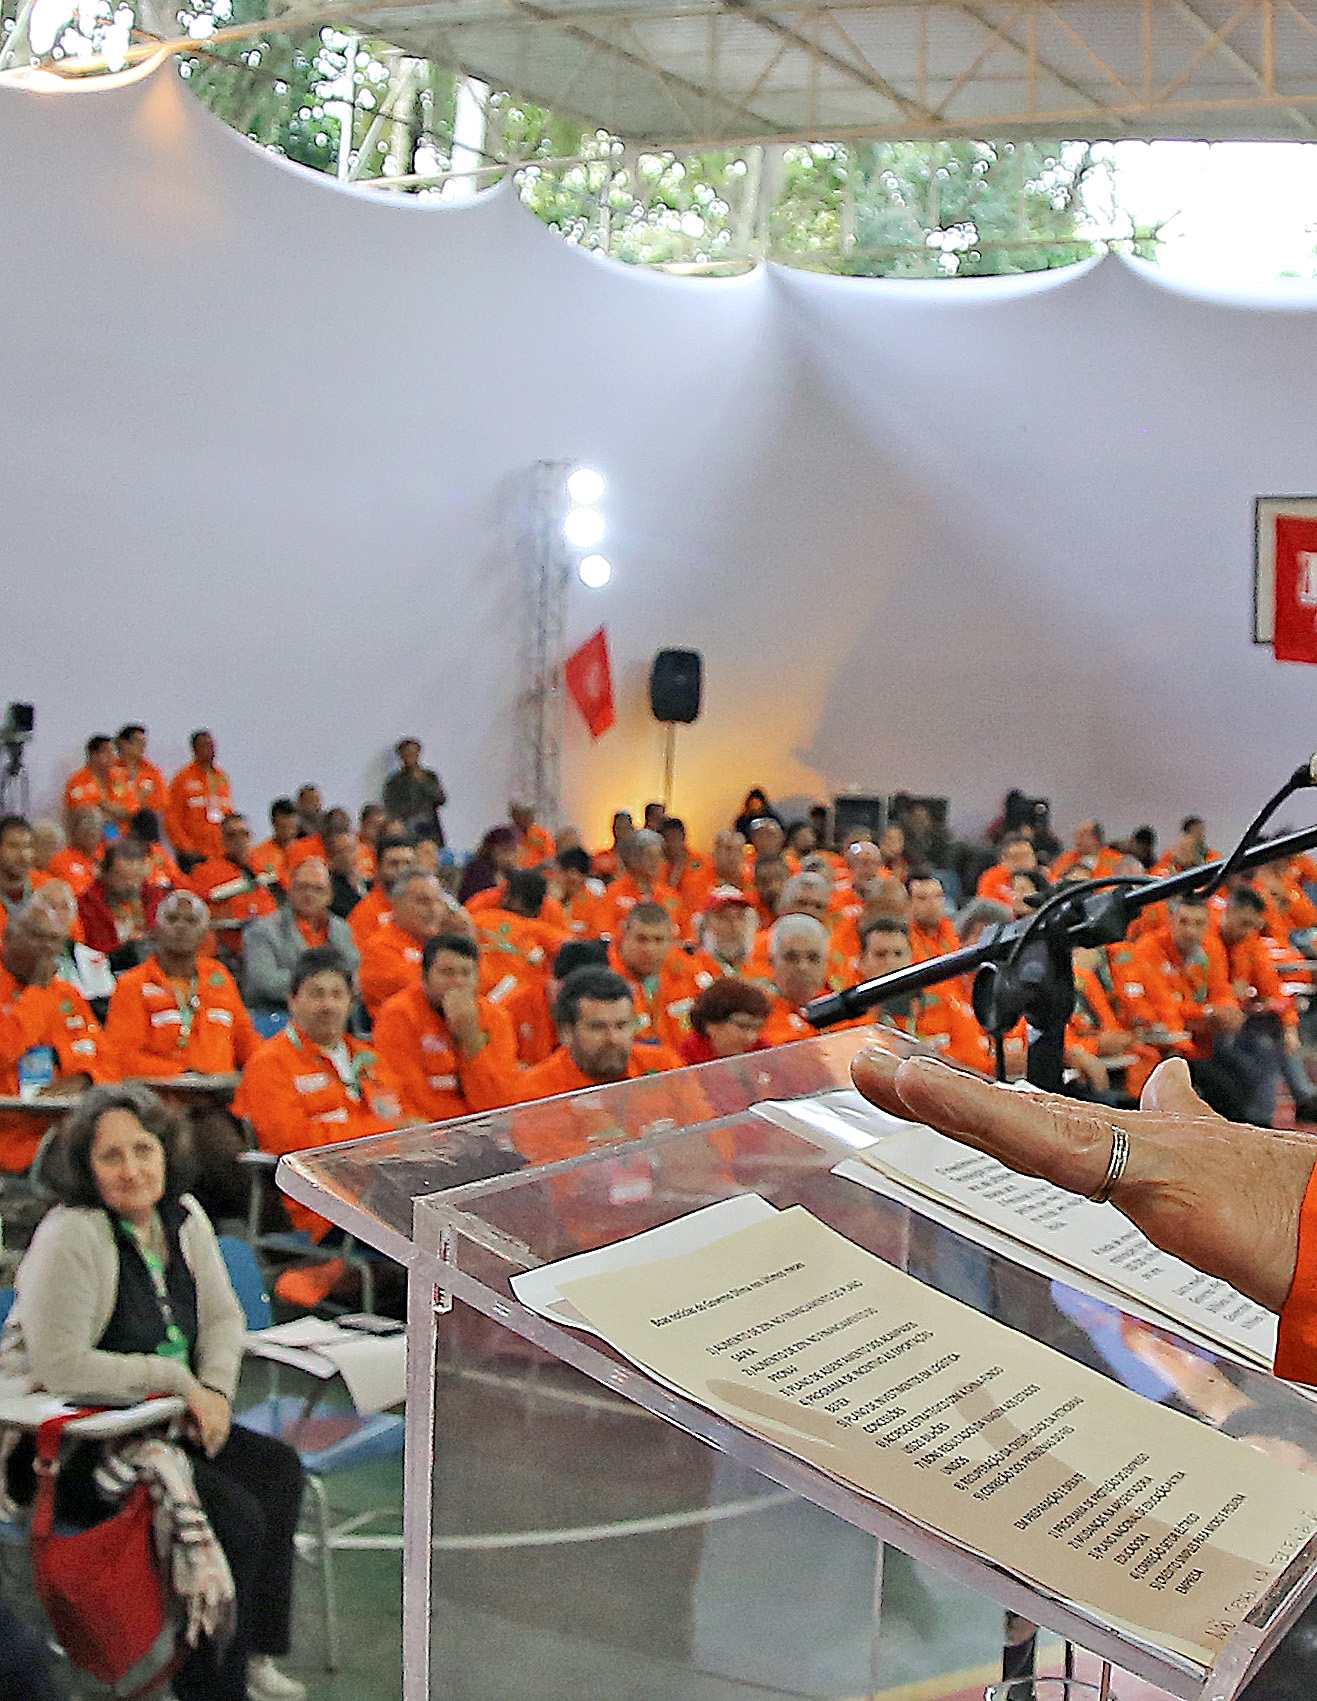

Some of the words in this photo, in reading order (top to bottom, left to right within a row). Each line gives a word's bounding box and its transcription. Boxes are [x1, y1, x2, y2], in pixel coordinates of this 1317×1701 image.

[710, 1331, 753, 1352] AUMENTO
[729, 1347, 760, 1362] SAFRA
[748, 1351, 790, 1372] AUMENTO
[786, 1376, 815, 1392] PLANO
[866, 1340, 887, 1351] DOS
[803, 1378, 849, 1403] PROGRAMA
[842, 1407, 871, 1424] PLANO
[872, 1375, 926, 1406] INVESTIMENTOS
[859, 1405, 908, 1434] CONCESSÕES
[880, 1423, 915, 1444] ACORDO
[943, 1392, 965, 1405] COM
[920, 1450, 945, 1465] BONS
[937, 1426, 980, 1454] RESULTADOS
[981, 1406, 1009, 1424] VIAGEM
[1001, 1399, 1020, 1410] AOS
[1012, 1384, 1042, 1403] ESTADOS
[940, 1455, 971, 1476] UNIDOS
[978, 1470, 1018, 1498] CORREÇÃO
[1008, 1461, 1029, 1475] DOS
[1020, 1438, 1059, 1466] PROBLEMAS
[1059, 1472, 1088, 1492] DEBATE
[1053, 1504, 1092, 1535] PROGRAMA
[1094, 1535, 1121, 1556] PLANO
[1114, 1532, 1152, 1566] EDUCADORA
[1157, 1531, 1183, 1551] SETOR
[1191, 1529, 1214, 1546] PARA
